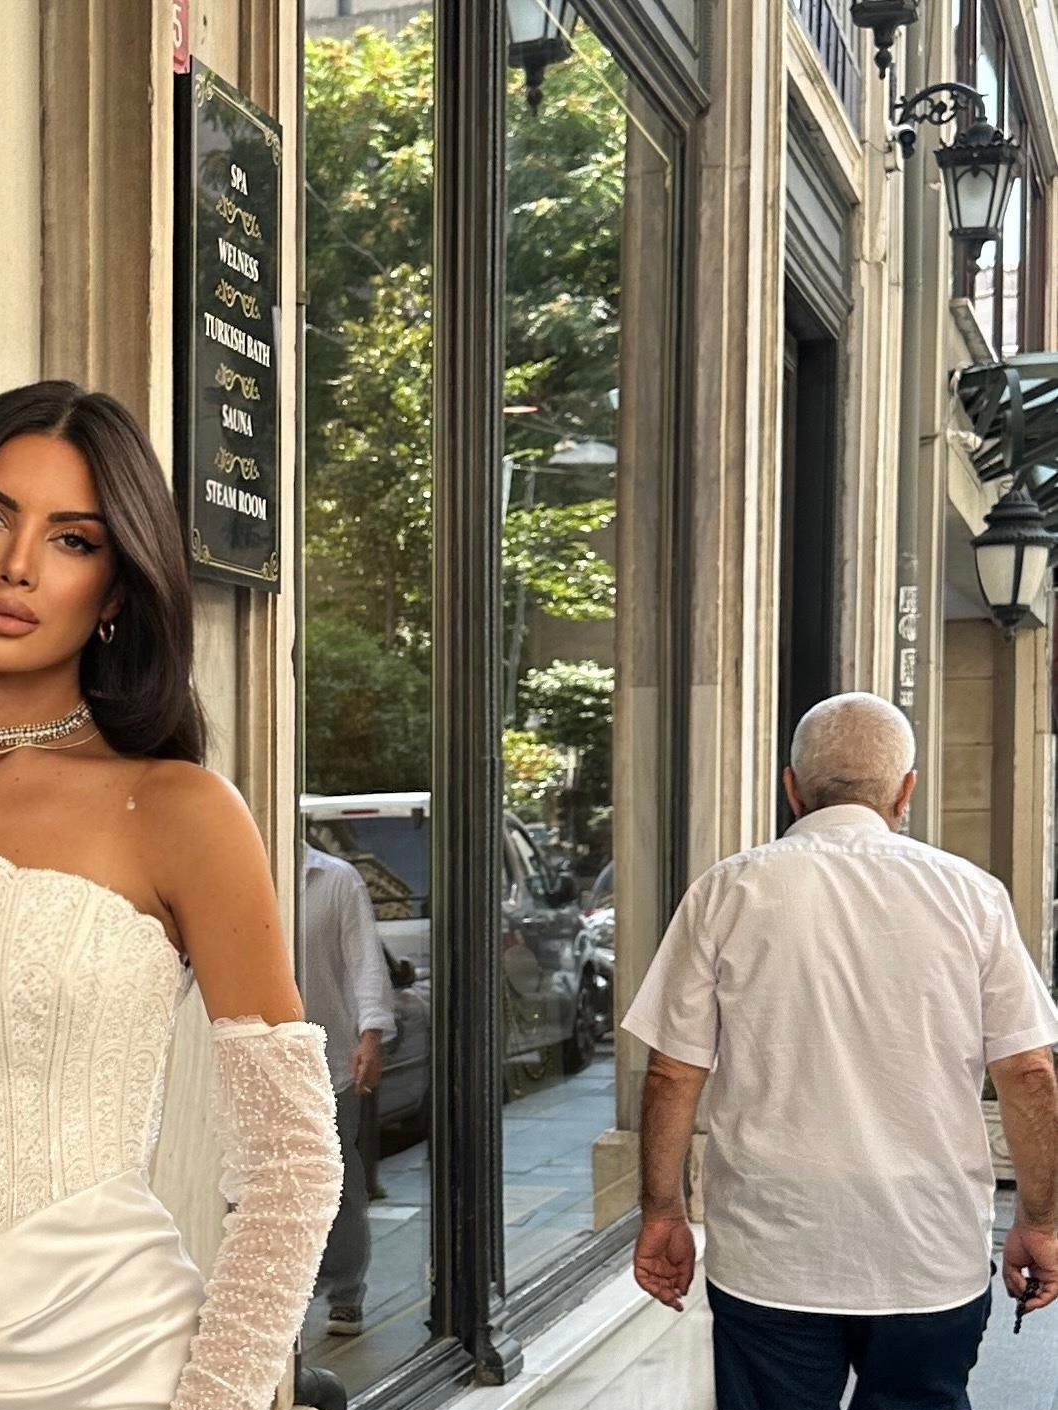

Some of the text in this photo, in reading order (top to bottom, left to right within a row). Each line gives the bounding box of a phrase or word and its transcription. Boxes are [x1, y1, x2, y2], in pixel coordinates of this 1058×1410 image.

[230, 163, 248, 196] SPA
[218, 237, 259, 283] WELNESS
[204, 312, 271, 368] TURKISH BATH
[222, 404, 253, 437] SAUNA
[205, 479, 267, 521] STEAM ROOM
